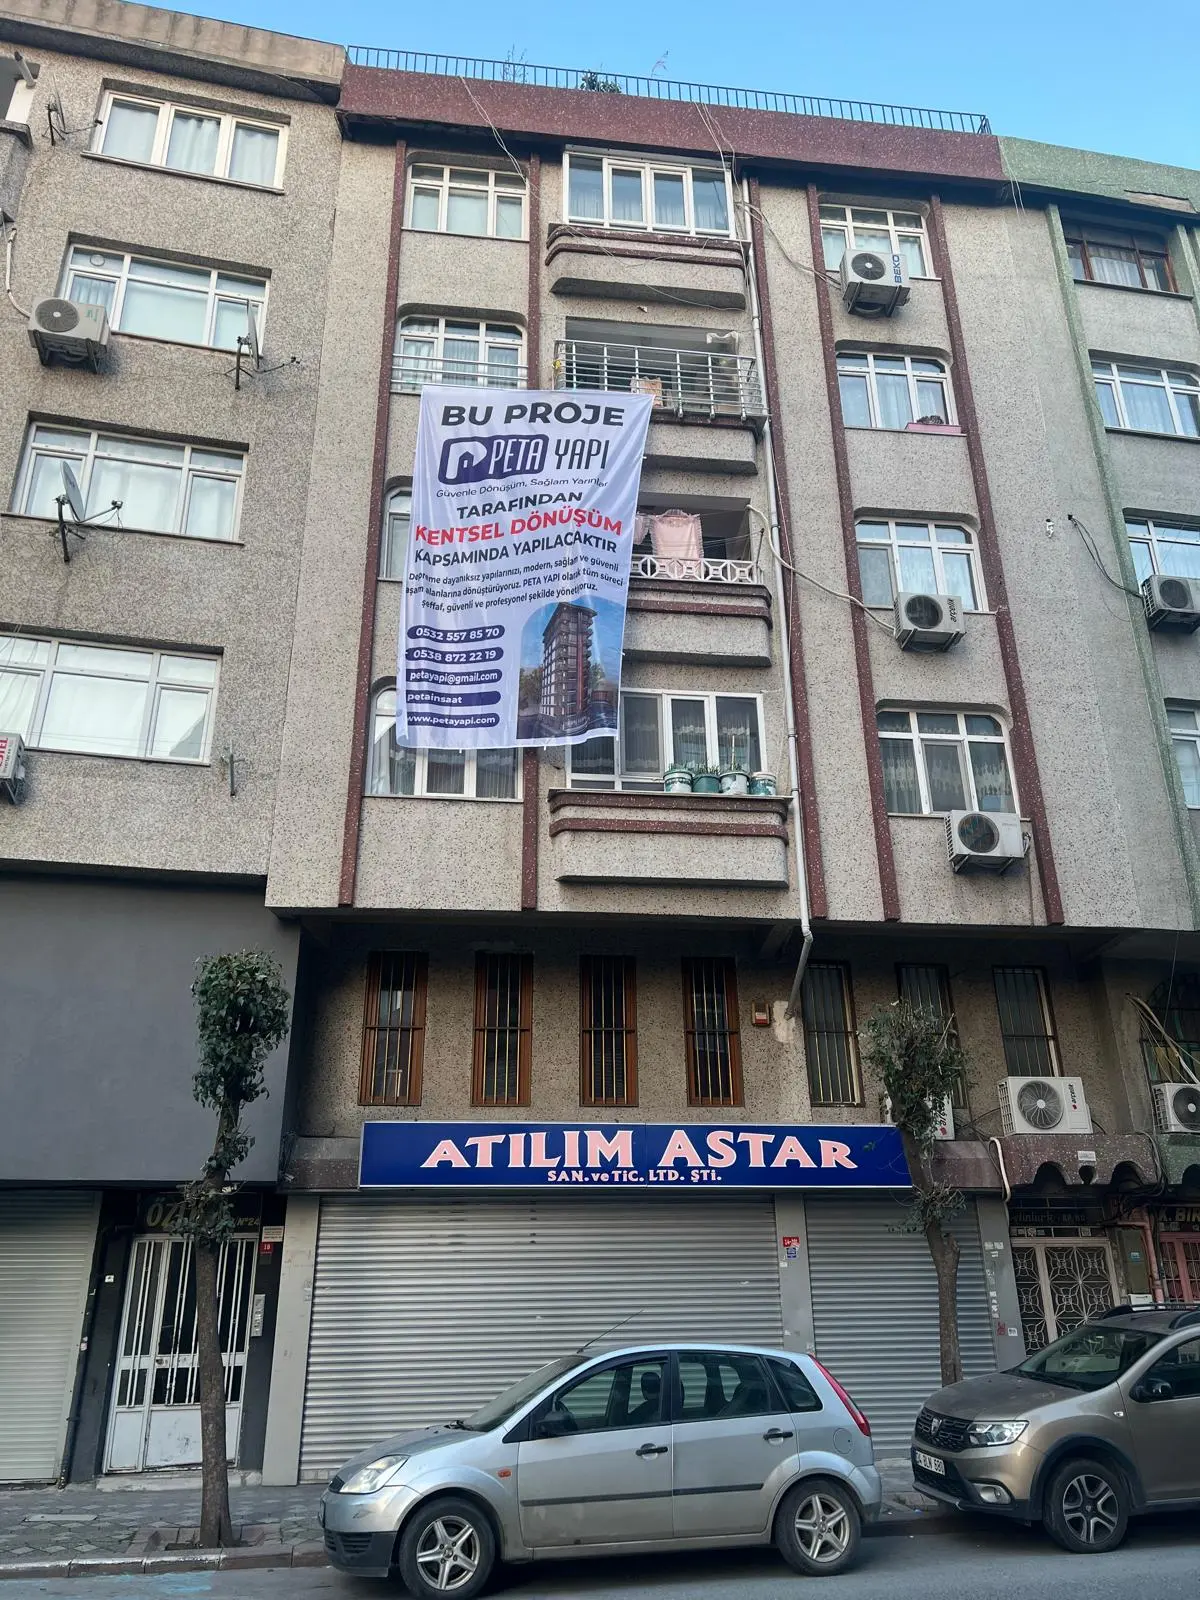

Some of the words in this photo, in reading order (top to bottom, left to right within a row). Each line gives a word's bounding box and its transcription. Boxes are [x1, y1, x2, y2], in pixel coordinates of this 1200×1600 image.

[892, 254, 902, 283] BEKO
[441, 406, 493, 426] BU
[503, 402, 625, 426] PROJE
[489, 438, 544, 475] PETA
[554, 438, 609, 469] YAPI
[436, 489, 477, 498] Güvenle
[480, 481, 527, 494] Dönüşüm,
[530, 478, 568, 487] Sağlam
[572, 477, 607, 487] Yarınlar
[457, 492, 583, 519] TARAFINDAN
[415, 522, 505, 546] KENTSEL
[510, 505, 623, 536] DÖNÜŞÜM
[415, 544, 510, 567] KAPSAMINDA
[513, 530, 618, 556] YAPILACAKTIR
[425, 586, 462, 598] alanlarına
[462, 581, 522, 596] dönüştürüyoruz.
[523, 576, 541, 587] PETA
[543, 572, 560, 583] YAPI
[582, 568, 599, 577] tüm
[600, 573, 624, 586] süreci
[442, 573, 481, 586] dayanıksız
[481, 567, 522, 582] yapılarınızı,
[523, 561, 553, 573] modern,
[590, 557, 619, 572] güvenli
[447, 600, 473, 613] güvenli
[485, 593, 528, 609] profesyonel
[528, 588, 555, 602] şekilde
[416, 628, 444, 640] 0532
[446, 632, 467, 641] 557
[469, 630, 483, 639] 85
[485, 628, 500, 637] 70
[413, 650, 442, 660] 0538
[445, 653, 467, 662] 872
[469, 652, 483, 660] 22
[485, 650, 497, 660] 19
[410, 670, 498, 685] petayapi@gmail.com
[407, 693, 463, 703] petainsaat
[420, 1130, 635, 1168] ATILIM
[657, 1129, 859, 1169] ASTAR
[547, 1170, 590, 1182] SAN.
[591, 1172, 609, 1182] ve
[648, 1169, 685, 1181] LTD.
